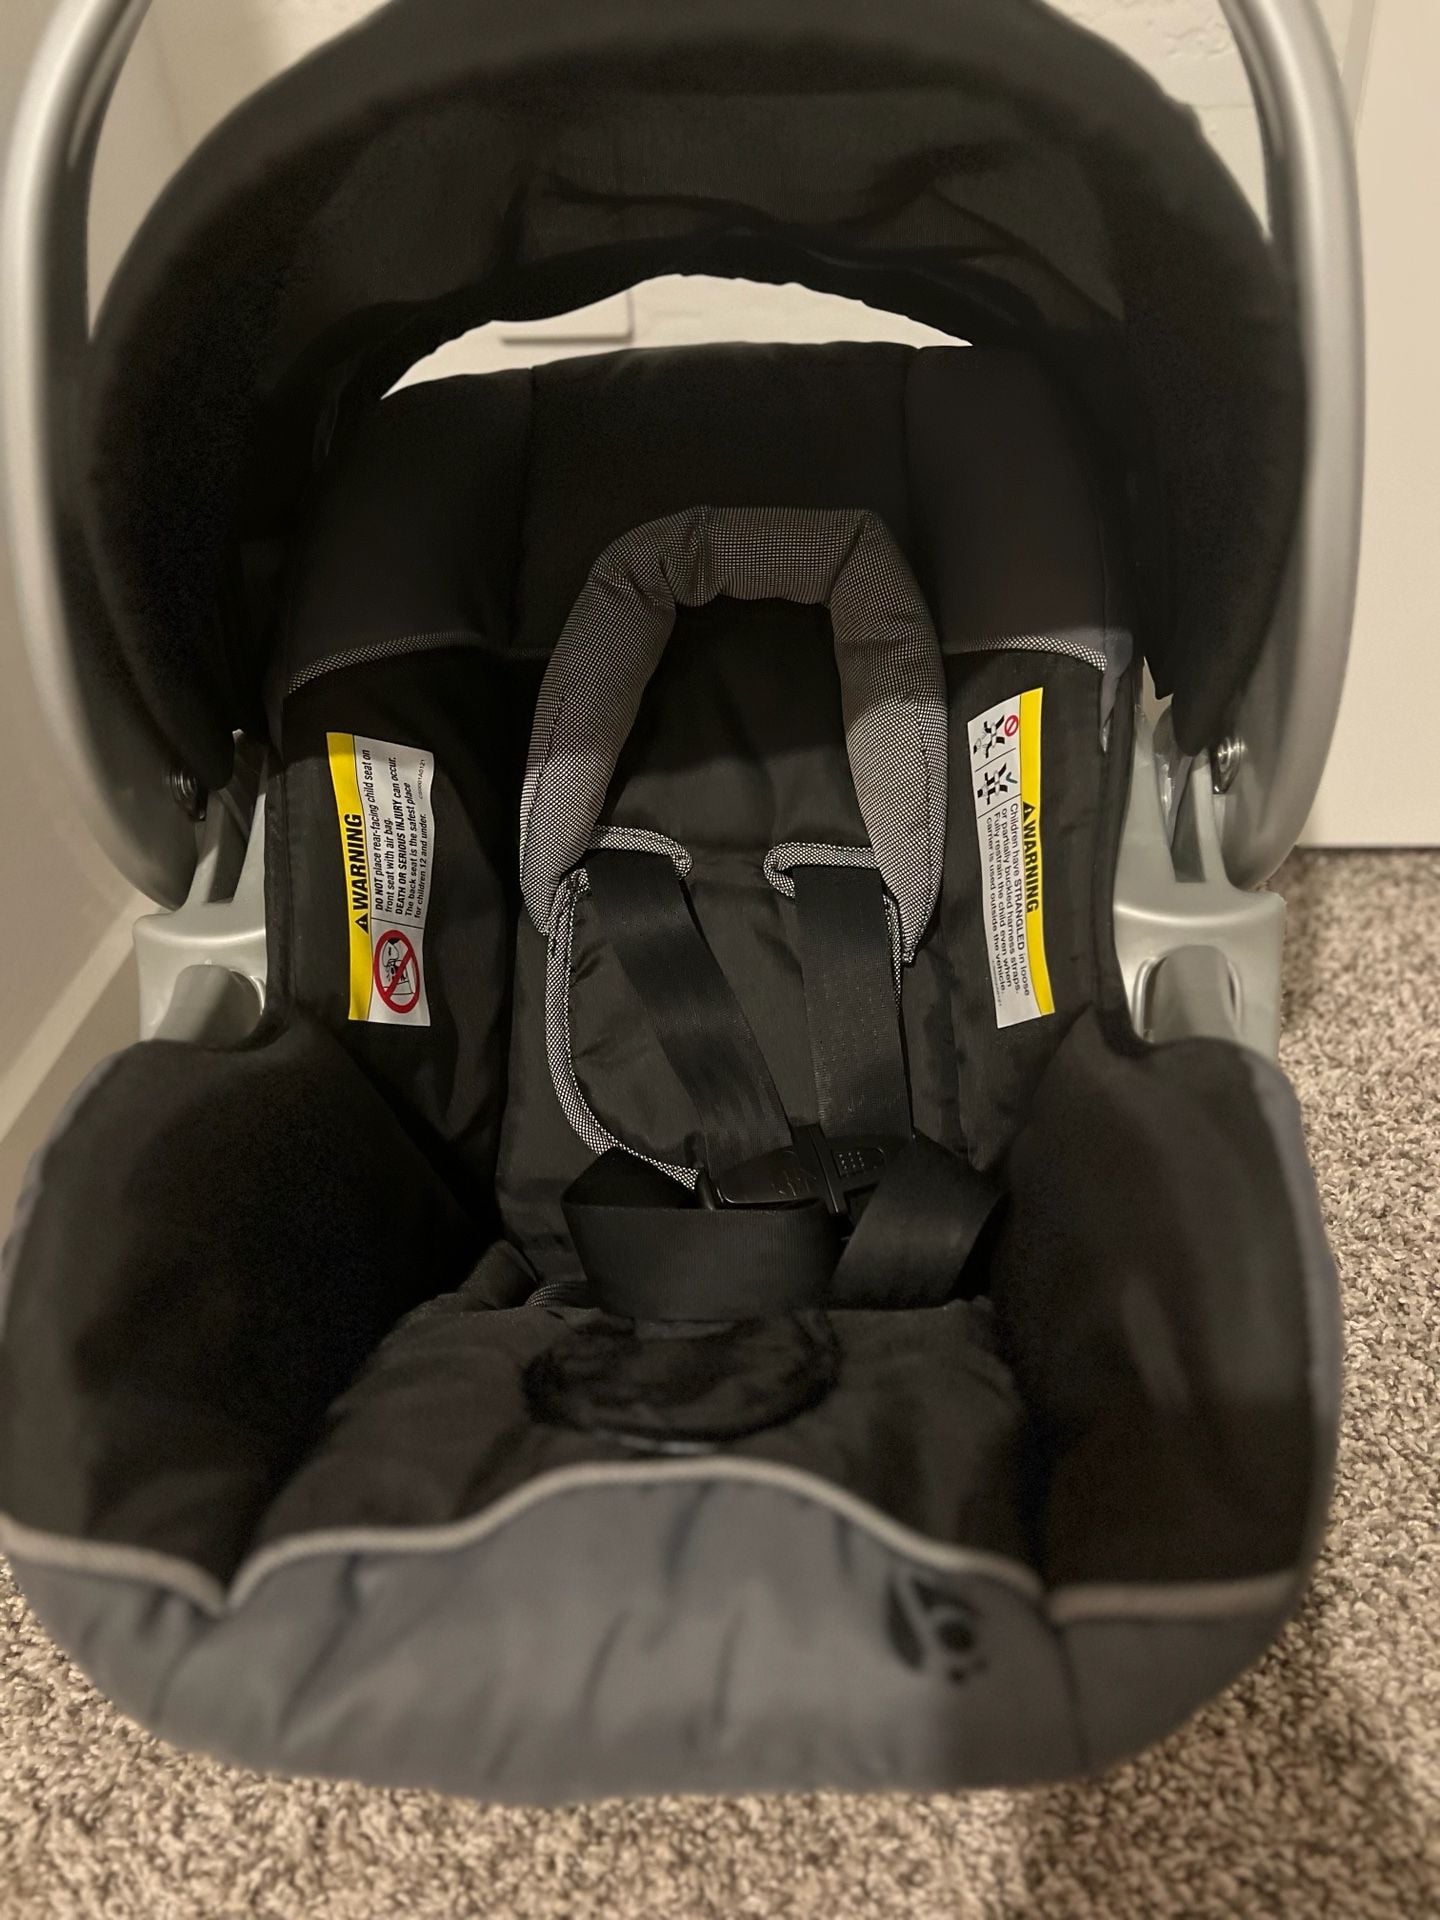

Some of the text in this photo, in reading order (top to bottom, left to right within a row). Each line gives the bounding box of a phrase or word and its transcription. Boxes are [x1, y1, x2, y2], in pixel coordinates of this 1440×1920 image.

[404, 783, 415, 805] place
[362, 750, 384, 910] DO NOT place rear-facing child seat on
[388, 757, 407, 915] DEATH OR SERIOUS INJURY can occur.
[406, 806, 417, 832] safest
[1010, 803, 1019, 848] Children
[408, 833, 417, 847] the
[409, 849, 417, 857] is
[990, 852, 994, 861] is
[344, 813, 368, 910] WARNING
[384, 818, 394, 912] front seat with air bag.
[409, 858, 417, 876] seat
[419, 858, 427, 868] 12
[1023, 819, 1039, 912] WARNING
[416, 871, 426, 905] children
[1001, 808, 1020, 993] or partially buckled harness straps.
[405, 901, 414, 916] The
[991, 893, 1000, 932] outside
[995, 840, 1003, 879] restrain
[1003, 958, 1012, 987] when
[1014, 879, 1025, 950] STRANGLED
[993, 934, 1001, 951] the
[1018, 953, 1026, 964] in
[996, 954, 1006, 993] vehicle.
[1020, 966, 1030, 996] loose
